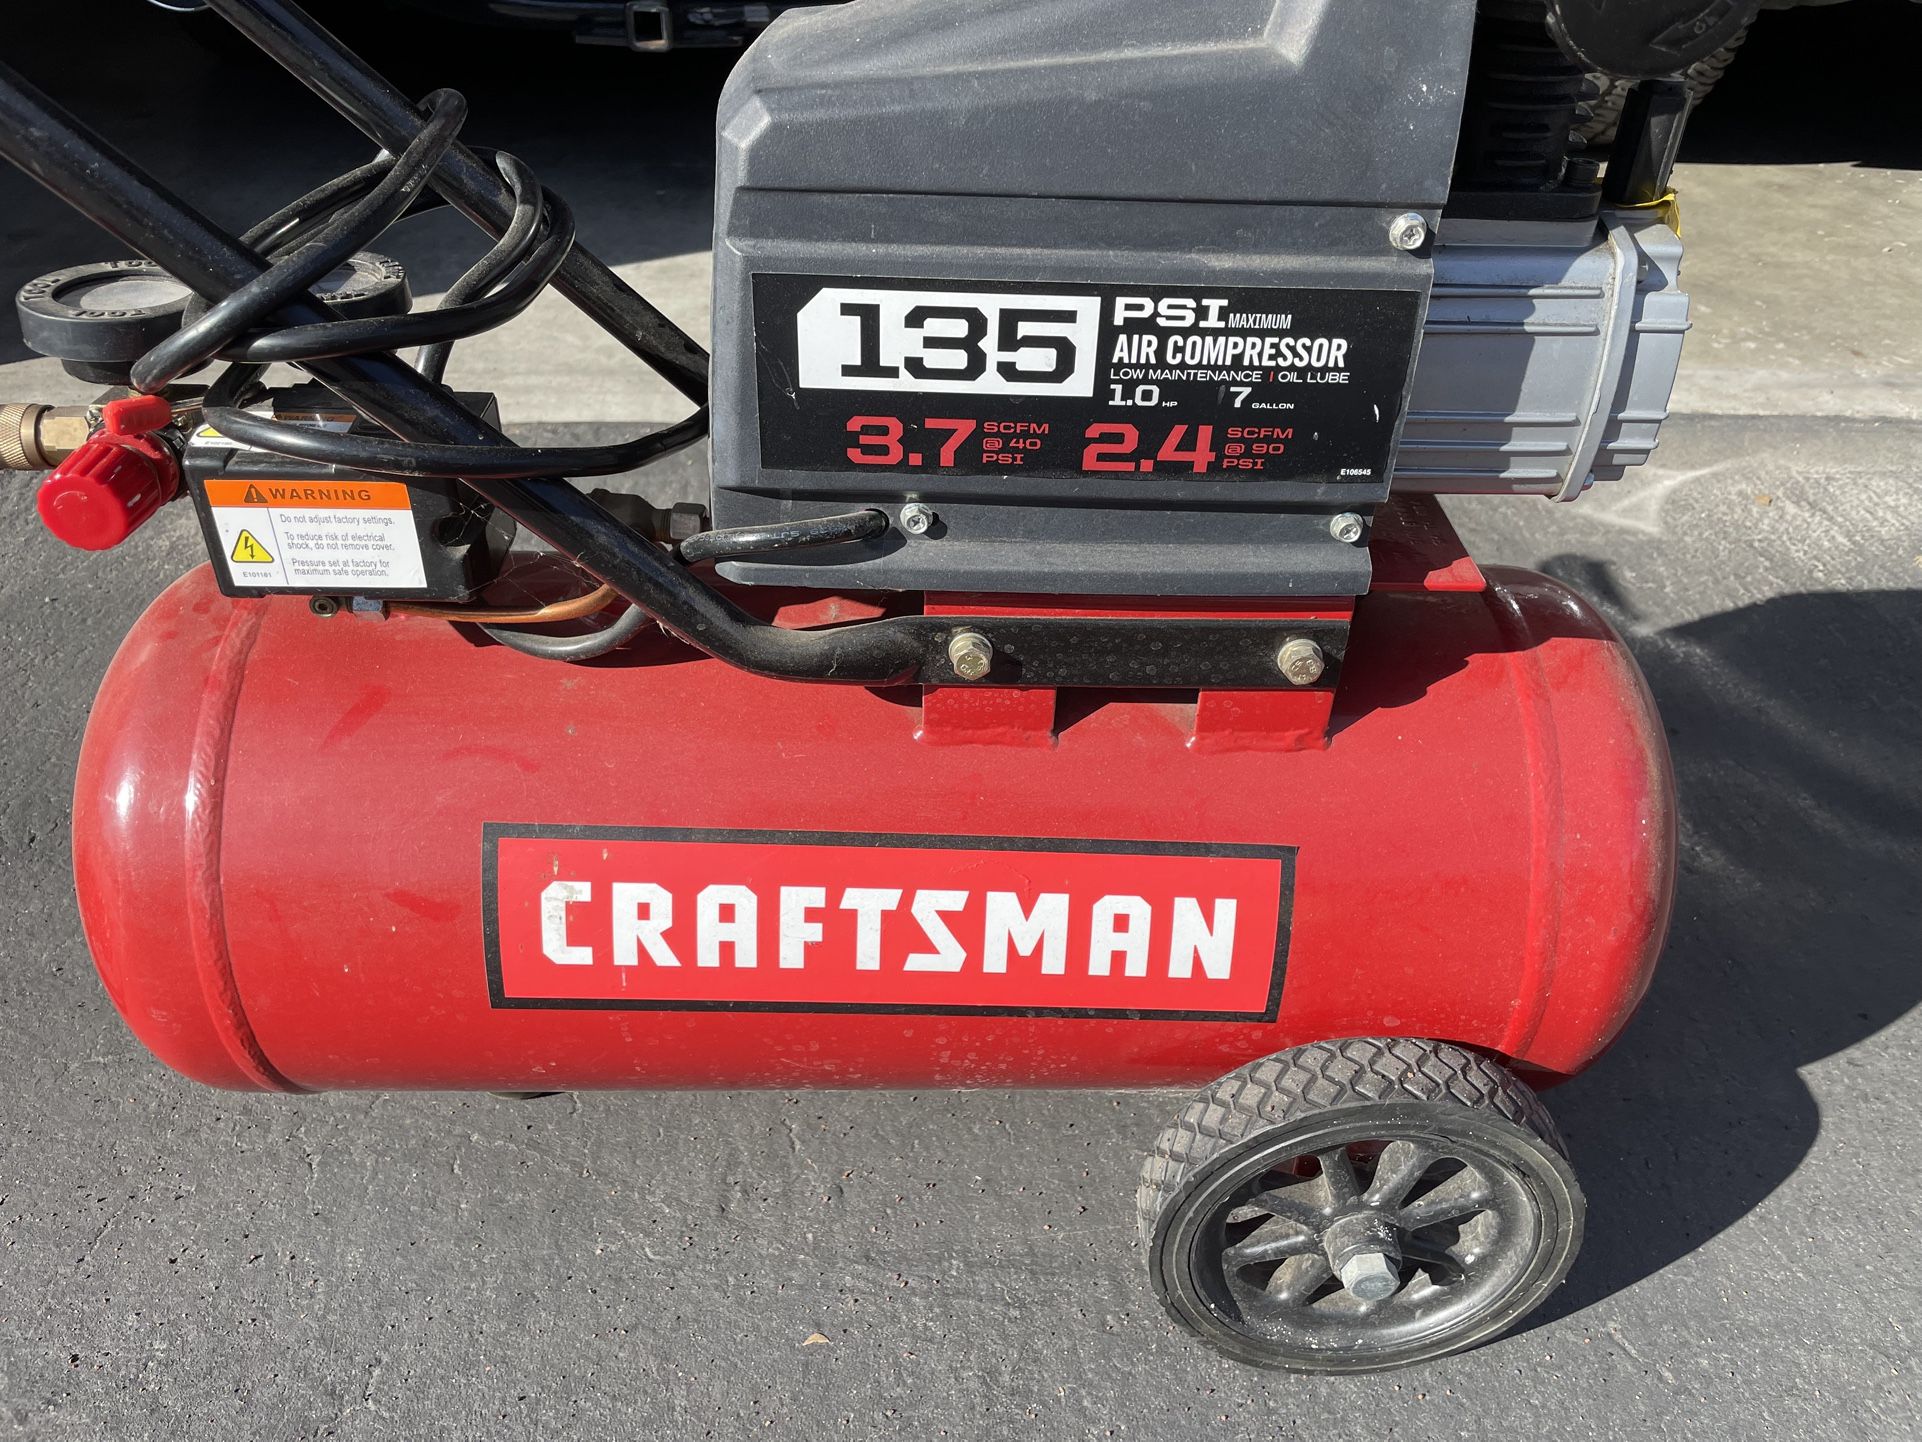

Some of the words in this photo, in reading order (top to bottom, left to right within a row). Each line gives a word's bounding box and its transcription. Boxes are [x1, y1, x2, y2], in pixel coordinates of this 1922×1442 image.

[1113, 297, 1228, 328] PSI
[1228, 313, 1292, 329] MAXIMUM
[840, 302, 1078, 383] 135
[1112, 334, 1158, 364] AIR
[1166, 335, 1348, 368] COMPRESSOR
[1110, 368, 1147, 380] LOW
[1149, 369, 1262, 382] MAINTENANCE
[1278, 371, 1302, 383] OIL
[1307, 372, 1350, 383] LUBE
[1108, 384, 1160, 406] 1.0
[1230, 386, 1252, 408] 7
[983, 422, 1049, 435] SCFM
[1227, 427, 1293, 439] SCFM
[845, 415, 977, 467] 3.7
[1010, 438, 1042, 450] 40
[1082, 422, 1216, 473] 2.4
[1252, 443, 1284, 454] 90
[982, 453, 1024, 465] PSI
[1222, 458, 1264, 469] PSI
[1340, 468, 1372, 476] E106545
[268, 487, 372, 501] WARNING
[280, 514, 291, 523] Do
[293, 515, 306, 523] not
[308, 515, 332, 526] adjust
[334, 515, 361, 526] factory
[363, 515, 395, 526] settings.
[284, 531, 294, 541] To
[297, 532, 323, 542] reduce
[325, 532, 340, 542] risk
[342, 532, 350, 542] of
[351, 532, 386, 542] electrical
[287, 542, 312, 551] shock,
[315, 542, 325, 550] do
[327, 542, 339, 550] not
[341, 542, 369, 551] remove
[372, 543, 395, 551] cover.
[292, 558, 325, 567] Pressure
[328, 559, 340, 567] set
[342, 559, 350, 567] at
[352, 559, 378, 570] factory
[379, 559, 390, 568] for
[294, 567, 331, 576] maximum
[333, 567, 350, 576] safe
[351, 568, 389, 578] operation.
[539, 880, 1237, 980] CRAFTSMAN
